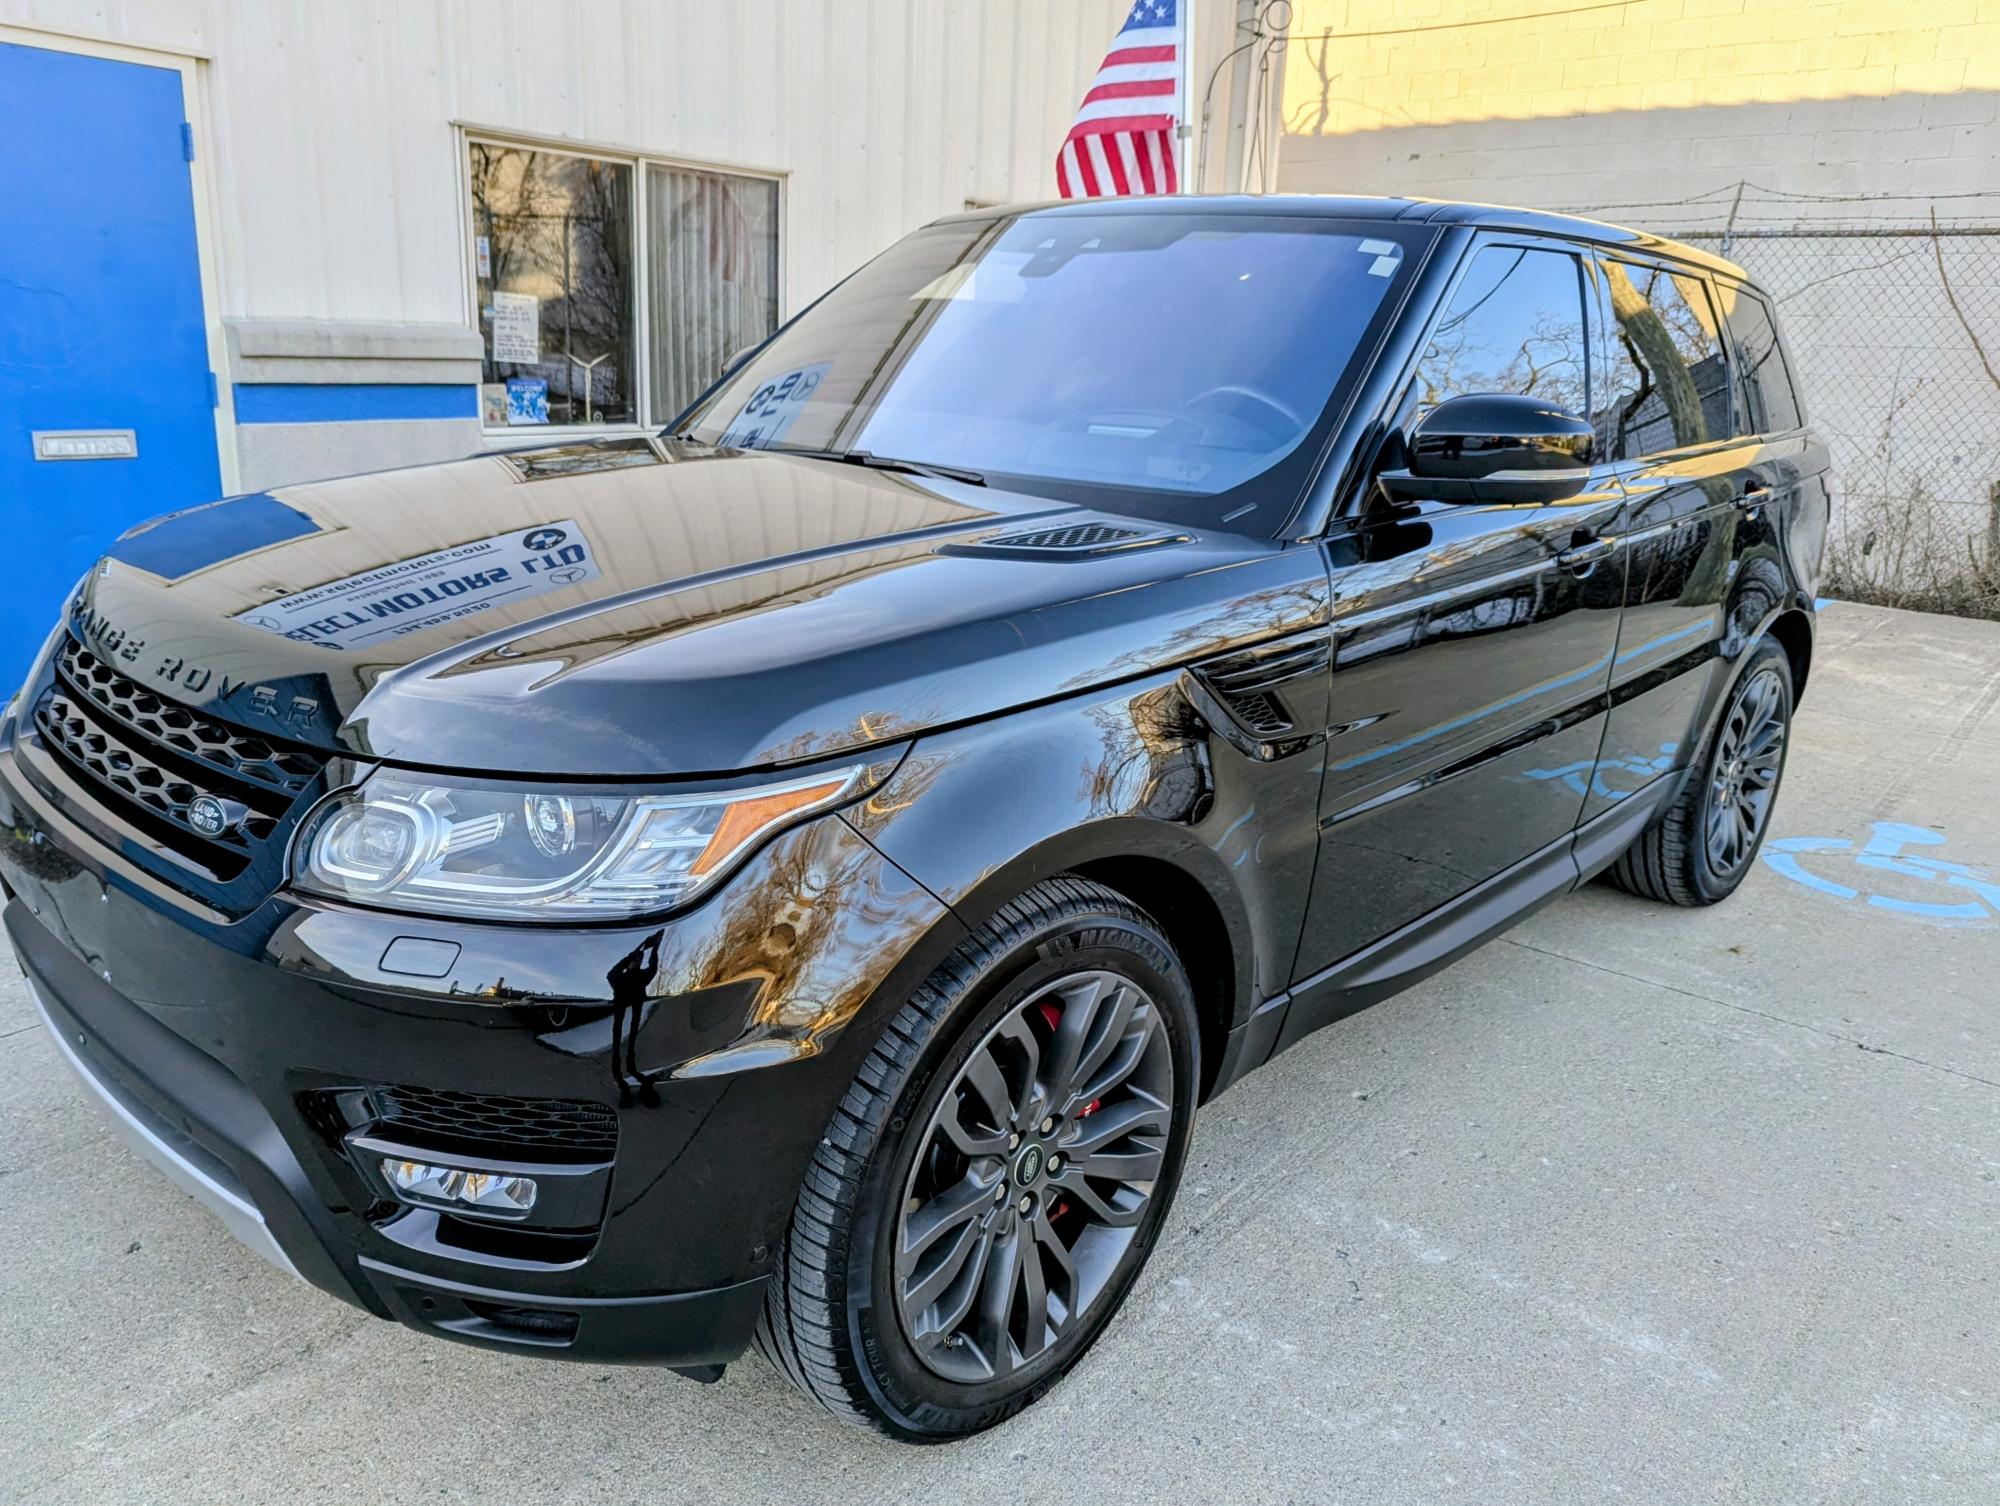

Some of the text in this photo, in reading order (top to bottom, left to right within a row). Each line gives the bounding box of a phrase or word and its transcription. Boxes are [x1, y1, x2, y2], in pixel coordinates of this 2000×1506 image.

[70, 596, 319, 728] RANGE ROVER
[193, 812, 218, 831] ROVER
[194, 801, 215, 818] LAND
[1078, 928, 1172, 977] MICHELIN
[865, 1337, 883, 1369] TOUR
